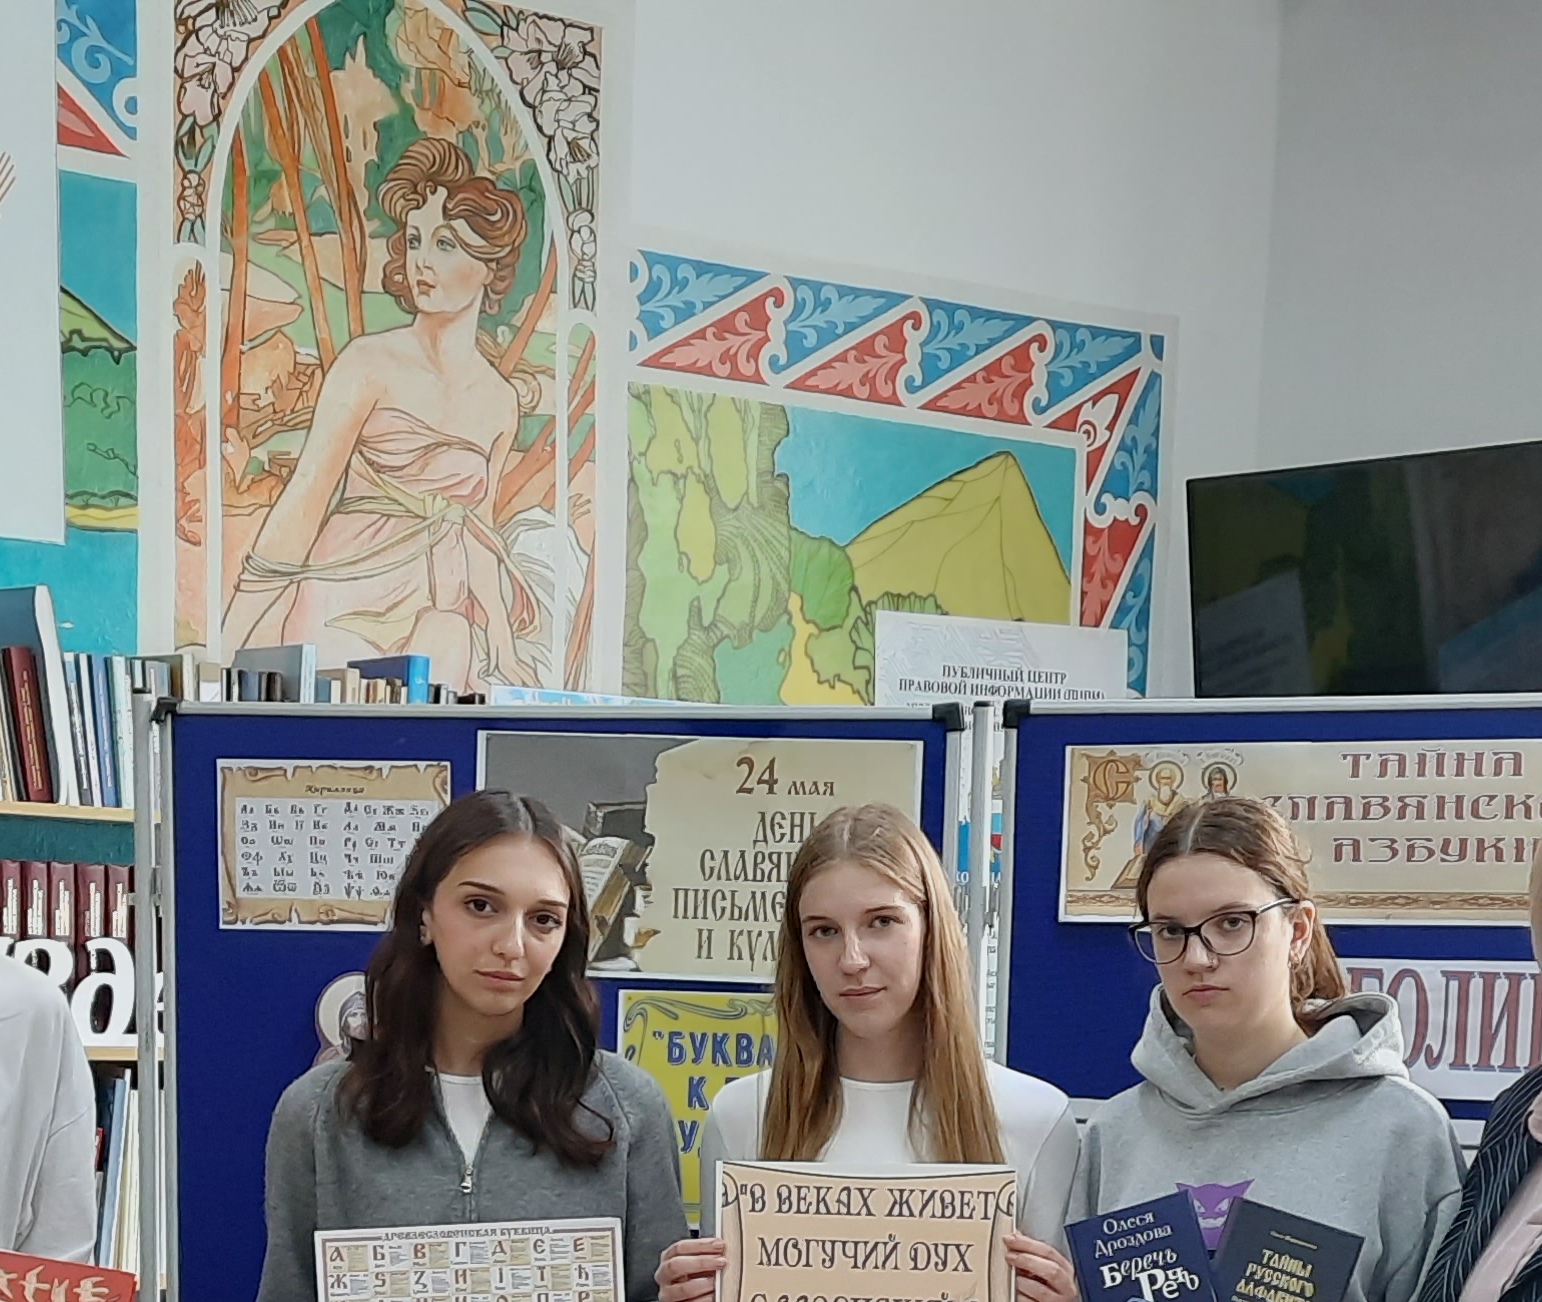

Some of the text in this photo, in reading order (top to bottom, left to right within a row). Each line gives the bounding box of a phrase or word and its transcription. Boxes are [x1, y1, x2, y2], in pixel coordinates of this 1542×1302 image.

[899, 679, 967, 694] ПРАВОВОЙ
[970, 682, 1061, 700] ИНФОРМАЦИИ
[942, 664, 1067, 684] ПУБЛИЧНЫЙ ЦЕНТР
[736, 757, 835, 796] 24 мая
[1341, 747, 1523, 779] ТАЙНА
[695, 928, 713, 959] И
[688, 1076, 710, 1110] К
[739, 1183, 996, 1220] "В ВЕКАХ ЖИВЕТ
[1103, 1211, 1155, 1235] Олеся
[329, 1247, 345, 1263] А
[372, 1245, 386, 1262] Б
[413, 1243, 426, 1260] В
[455, 1242, 466, 1258] Г
[492, 1241, 508, 1256] Д
[756, 1233, 975, 1272] МОГУЧИЙ ДУХ
[1094, 1224, 1173, 1258] Дроздова
[1099, 1248, 1177, 1288] Беречь
[1261, 1248, 1313, 1277] ТАЙНЫ
[1135, 1266, 1199, 1302] Речь
[1245, 1263, 1315, 1298] РУССКОГО
